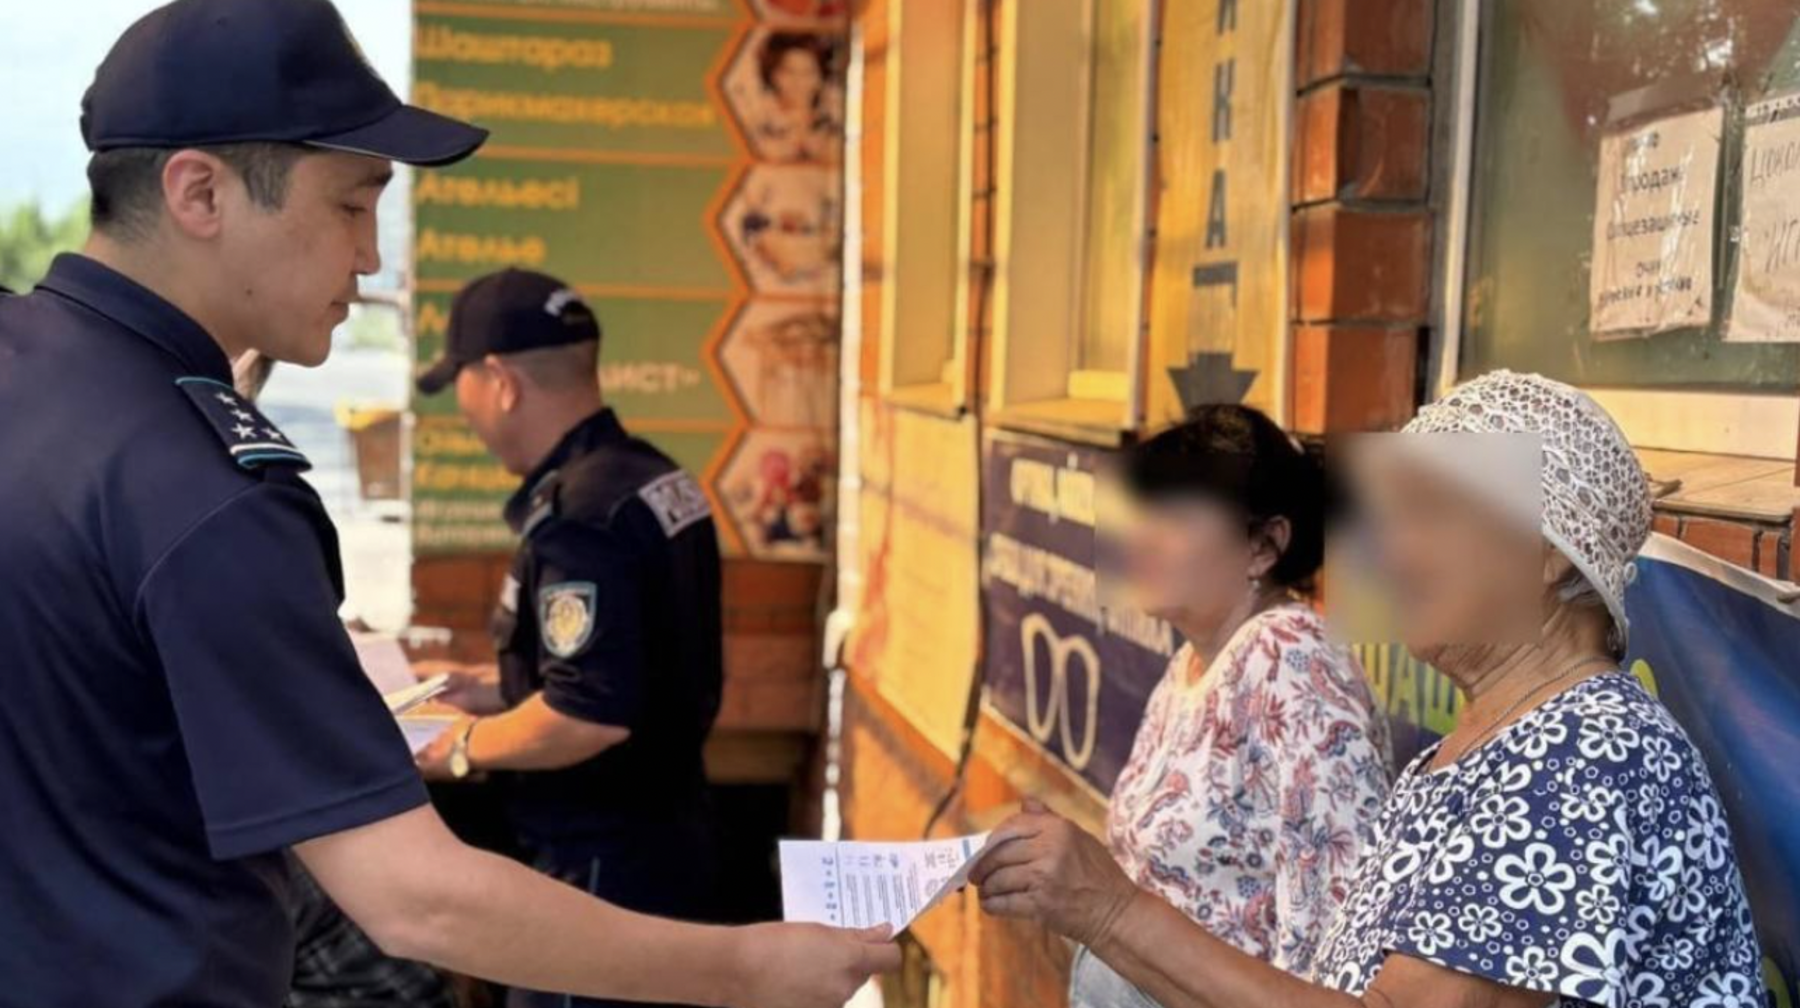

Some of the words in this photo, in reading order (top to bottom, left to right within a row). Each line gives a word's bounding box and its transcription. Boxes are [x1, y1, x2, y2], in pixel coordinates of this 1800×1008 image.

[416, 26, 612, 71] Шаштараз
[1750, 138, 1800, 187] ЦОКО
[417, 172, 579, 209] Ательесі
[417, 229, 546, 264] Ателье
[600, 361, 699, 394] ИСТ»
